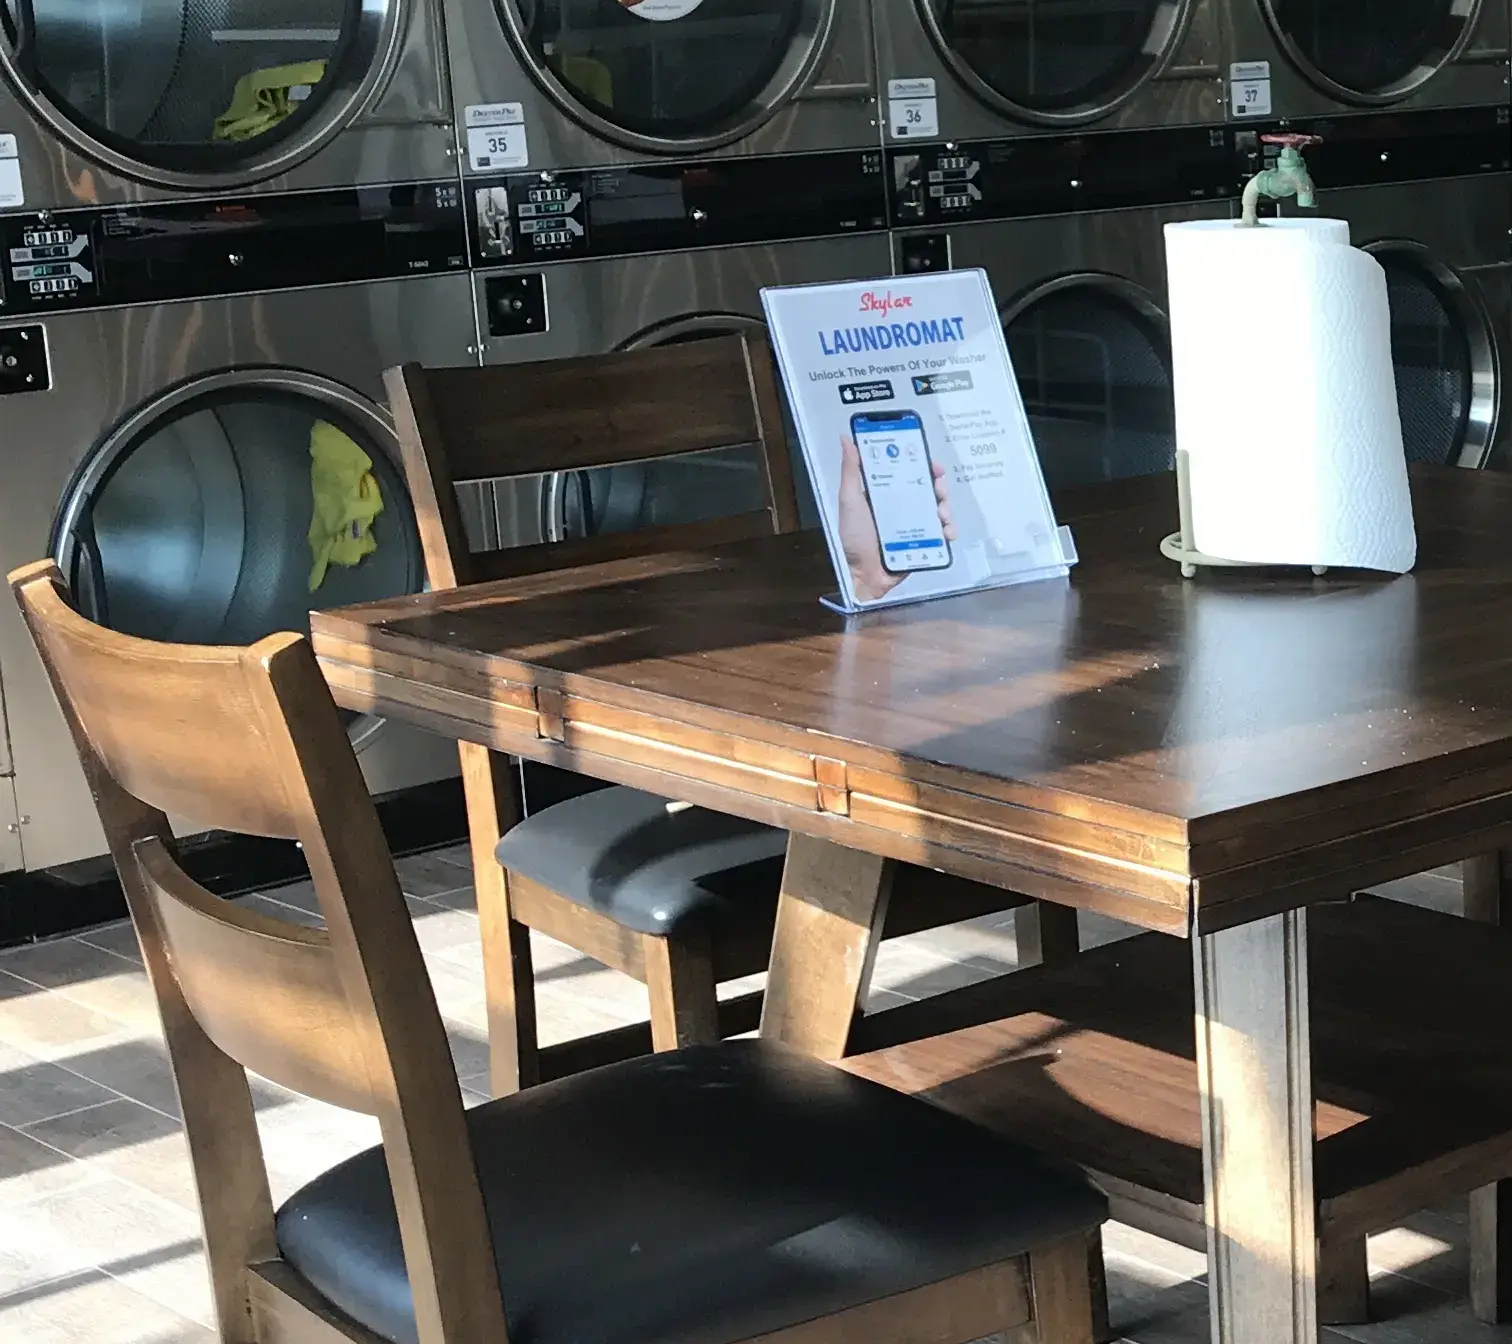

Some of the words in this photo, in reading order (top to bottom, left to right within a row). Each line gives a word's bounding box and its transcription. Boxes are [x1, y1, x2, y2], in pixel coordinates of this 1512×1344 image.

[1245, 89, 1258, 103] 37
[906, 109, 922, 123] 36
[488, 137, 507, 153] 35
[859, 290, 913, 318] Skylar
[818, 316, 965, 356] LAUNDROMAT
[808, 367, 846, 382] Unlock
[849, 366, 867, 377] The
[868, 364, 907, 376] Powers
[908, 360, 920, 371] Of
[922, 357, 947, 369] Your
